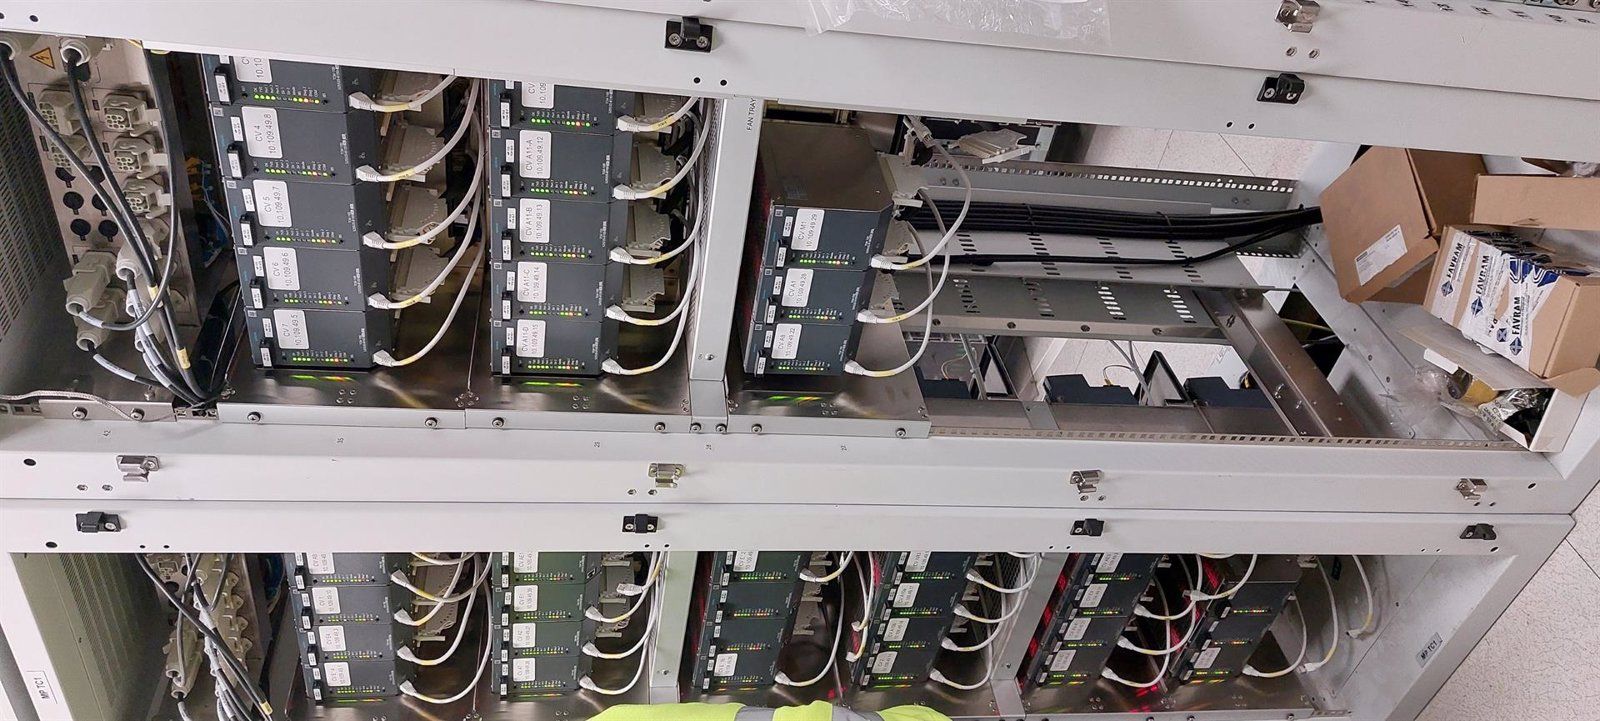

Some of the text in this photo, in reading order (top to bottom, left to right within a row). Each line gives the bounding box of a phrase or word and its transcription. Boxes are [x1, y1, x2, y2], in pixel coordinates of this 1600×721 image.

[528, 82, 536, 94] CV
[746, 98, 756, 131] FAN TRAY
[254, 130, 263, 142] CV
[264, 113, 276, 154] 10.109.49.8
[536, 136, 544, 175] 10.109.49.12
[526, 160, 533, 171] CV
[263, 202, 272, 212] CV
[272, 186, 284, 223] 10.109.49.7
[525, 225, 532, 236] CV
[797, 231, 805, 240] CV
[1446, 242, 1464, 279] FAVRAM
[273, 268, 280, 277] CV
[282, 252, 292, 286] 10.109.49.6
[1476, 255, 1490, 295] FAVRAM
[522, 287, 530, 296] CV
[788, 288, 796, 297] CV
[1511, 296, 1521, 335] FAVRAM
[282, 328, 290, 337] CV
[292, 314, 302, 346] 10.109.49.5
[522, 343, 529, 352] CV
[777, 342, 785, 350] CV
[1420, 640, 1438, 660] MP TC1
[34, 678, 50, 700] MP TC1
